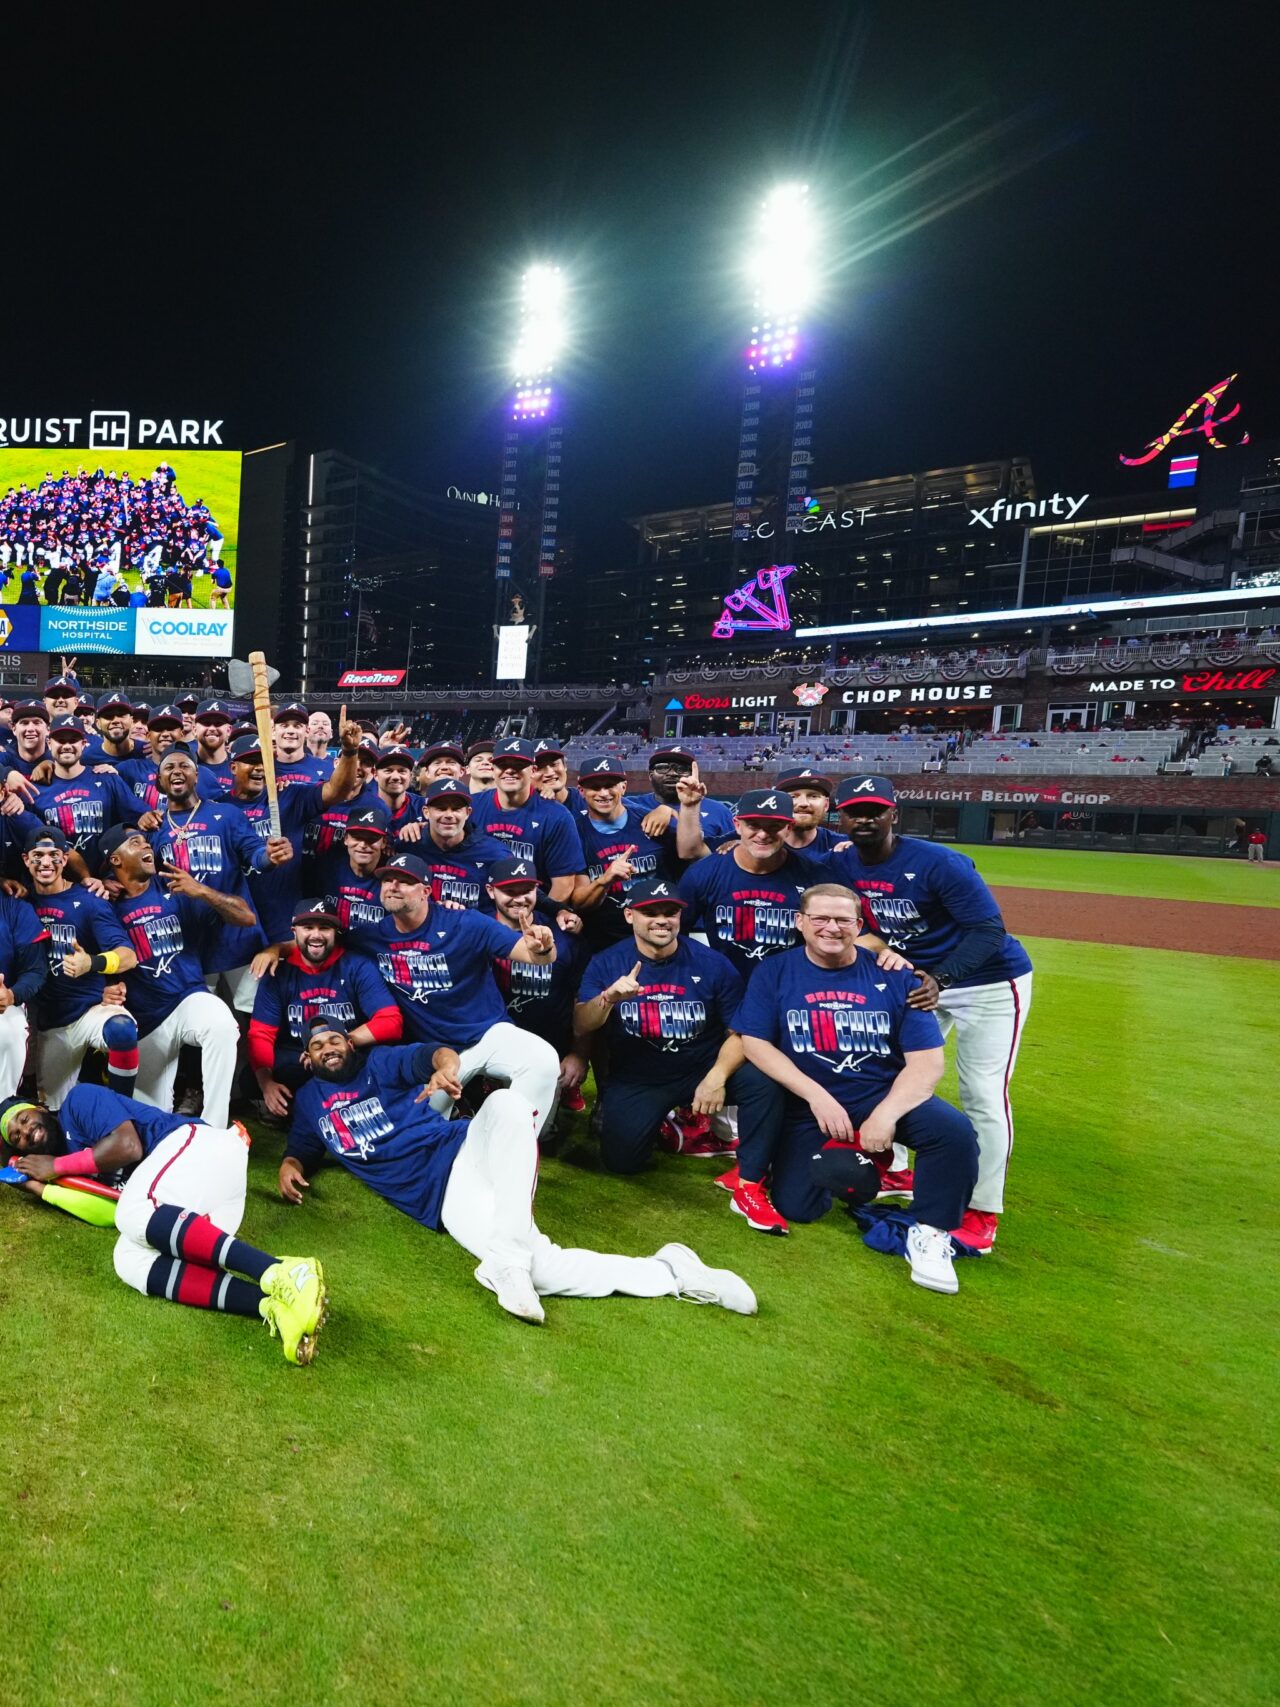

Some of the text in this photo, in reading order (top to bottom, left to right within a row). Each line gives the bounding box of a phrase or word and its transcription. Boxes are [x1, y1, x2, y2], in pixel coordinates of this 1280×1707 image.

[138, 419, 223, 444] PARK
[793, 454, 808, 463] 2012
[968, 493, 1090, 529] xfinity
[48, 620, 127, 631] NORTHSIDE
[150, 620, 228, 636] COOLRAY
[62, 631, 112, 640] HOSPITAL
[342, 672, 398, 684] RaceTrac
[1089, 669, 1277, 692] MADE TO Chill
[684, 693, 777, 710] Coors LIGHT
[842, 685, 993, 704] CHOP HOUSE
[894, 787, 926, 801] oors
[926, 790, 972, 800] LIGHT
[981, 790, 1039, 802] BELOW
[1061, 791, 1111, 805] CHOP
[732, 890, 787, 903] BRAVES
[804, 991, 867, 1005] BRAVES
[620, 1000, 706, 1040] CLINCHED
[786, 1009, 891, 1055] CLINCHED
